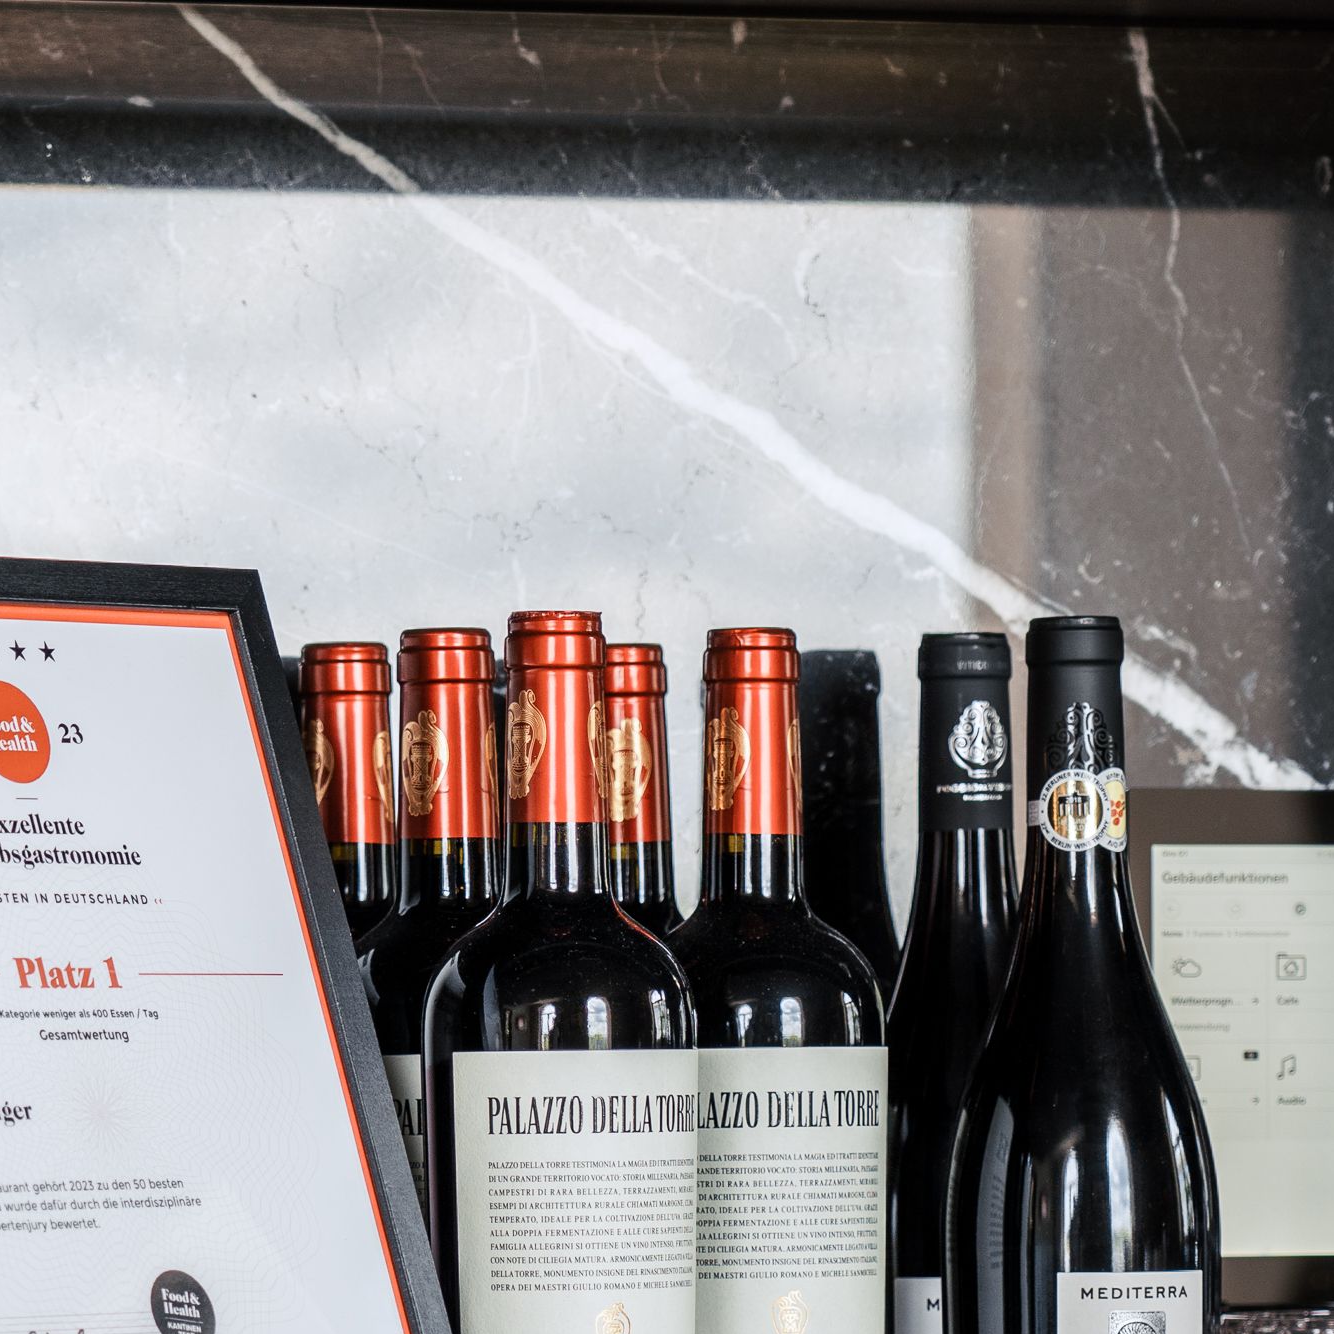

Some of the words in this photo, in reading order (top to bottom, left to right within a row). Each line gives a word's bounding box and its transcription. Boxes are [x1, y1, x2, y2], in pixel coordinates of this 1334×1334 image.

[58, 723, 83, 745] 23
[34, 893, 48, 905] IN
[54, 893, 149, 905] DEUTSCHLAND
[13, 957, 95, 989] Platz
[102, 956, 122, 989] 1
[0, 1009, 40, 1020] Kategorie
[43, 1010, 76, 1020] weniger
[79, 1009, 90, 1018] als
[92, 1009, 108, 1018] 400
[110, 1009, 134, 1018] Essen
[142, 1009, 158, 1019] Tag
[39, 1028, 129, 1042] Gesamtwertung
[488, 1095, 583, 1135] PALAZZO
[592, 1095, 653, 1133] DELLA
[656, 1094, 695, 1132] TORRE
[697, 1091, 758, 1129] LAZZO
[767, 1090, 830, 1128] DELLA
[834, 1089, 879, 1127] TORRE
[33, 1180, 67, 1195] gehört
[69, 1180, 94, 1192] 2023
[97, 1182, 109, 1191] zu
[112, 1179, 131, 1191] den
[133, 1178, 146, 1190] 50
[149, 1178, 184, 1189] besten
[5, 1200, 37, 1212] wurde
[40, 1199, 68, 1212] dafür
[71, 1198, 100, 1211] durch
[103, 1198, 118, 1210] die
[121, 1195, 202, 1210] interdisziplinäre
[50, 1218, 100, 1231] bewertet.
[161, 1288, 201, 1306] Food&
[1081, 1286, 1187, 1300] MEDITERRA
[163, 1302, 200, 1318] Health
[167, 1322, 202, 1333] KANTINEN
